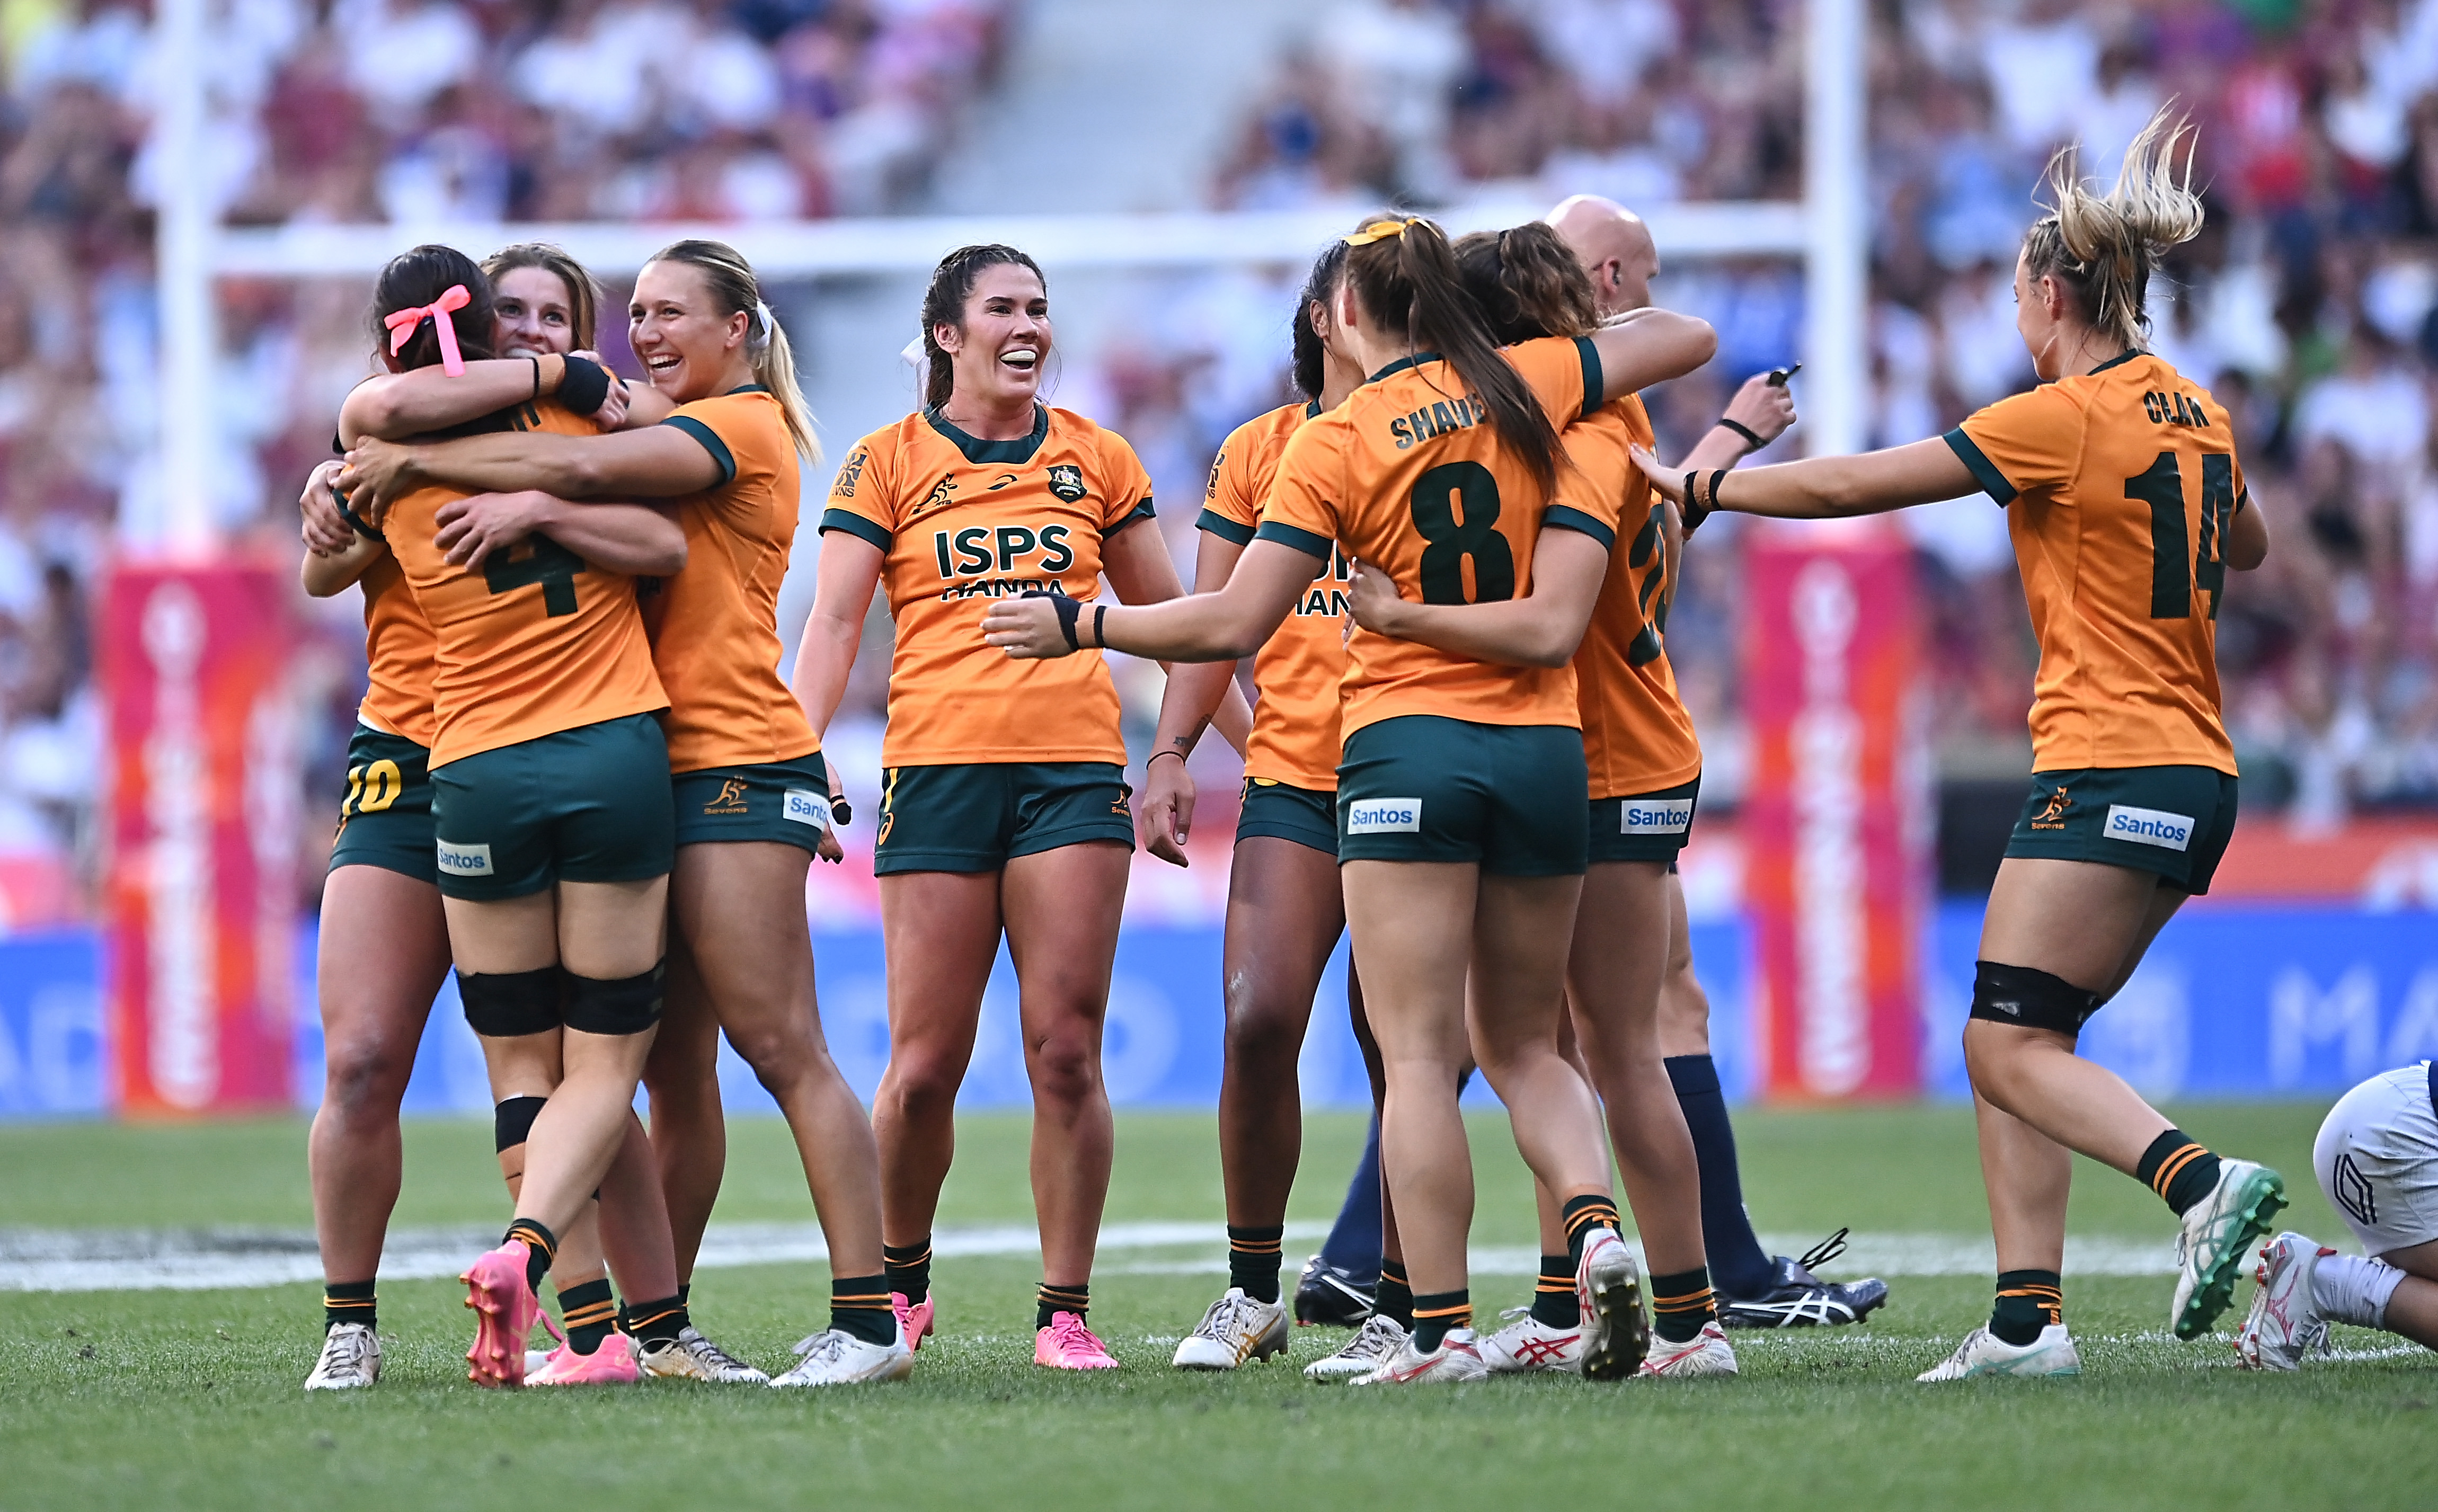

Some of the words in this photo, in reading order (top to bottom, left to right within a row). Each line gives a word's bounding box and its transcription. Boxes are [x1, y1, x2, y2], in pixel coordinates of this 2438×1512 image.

[934, 523, 1074, 580] ISPS
[1411, 461, 1515, 605] 8
[2125, 452, 2235, 620] 14
[483, 531, 586, 617] 4
[342, 759, 401, 816] 10
[1353, 808, 1413, 825] Santos
[1628, 808, 1688, 825] Santos
[2113, 814, 2187, 842] Santos
[439, 848, 485, 868] Santos
